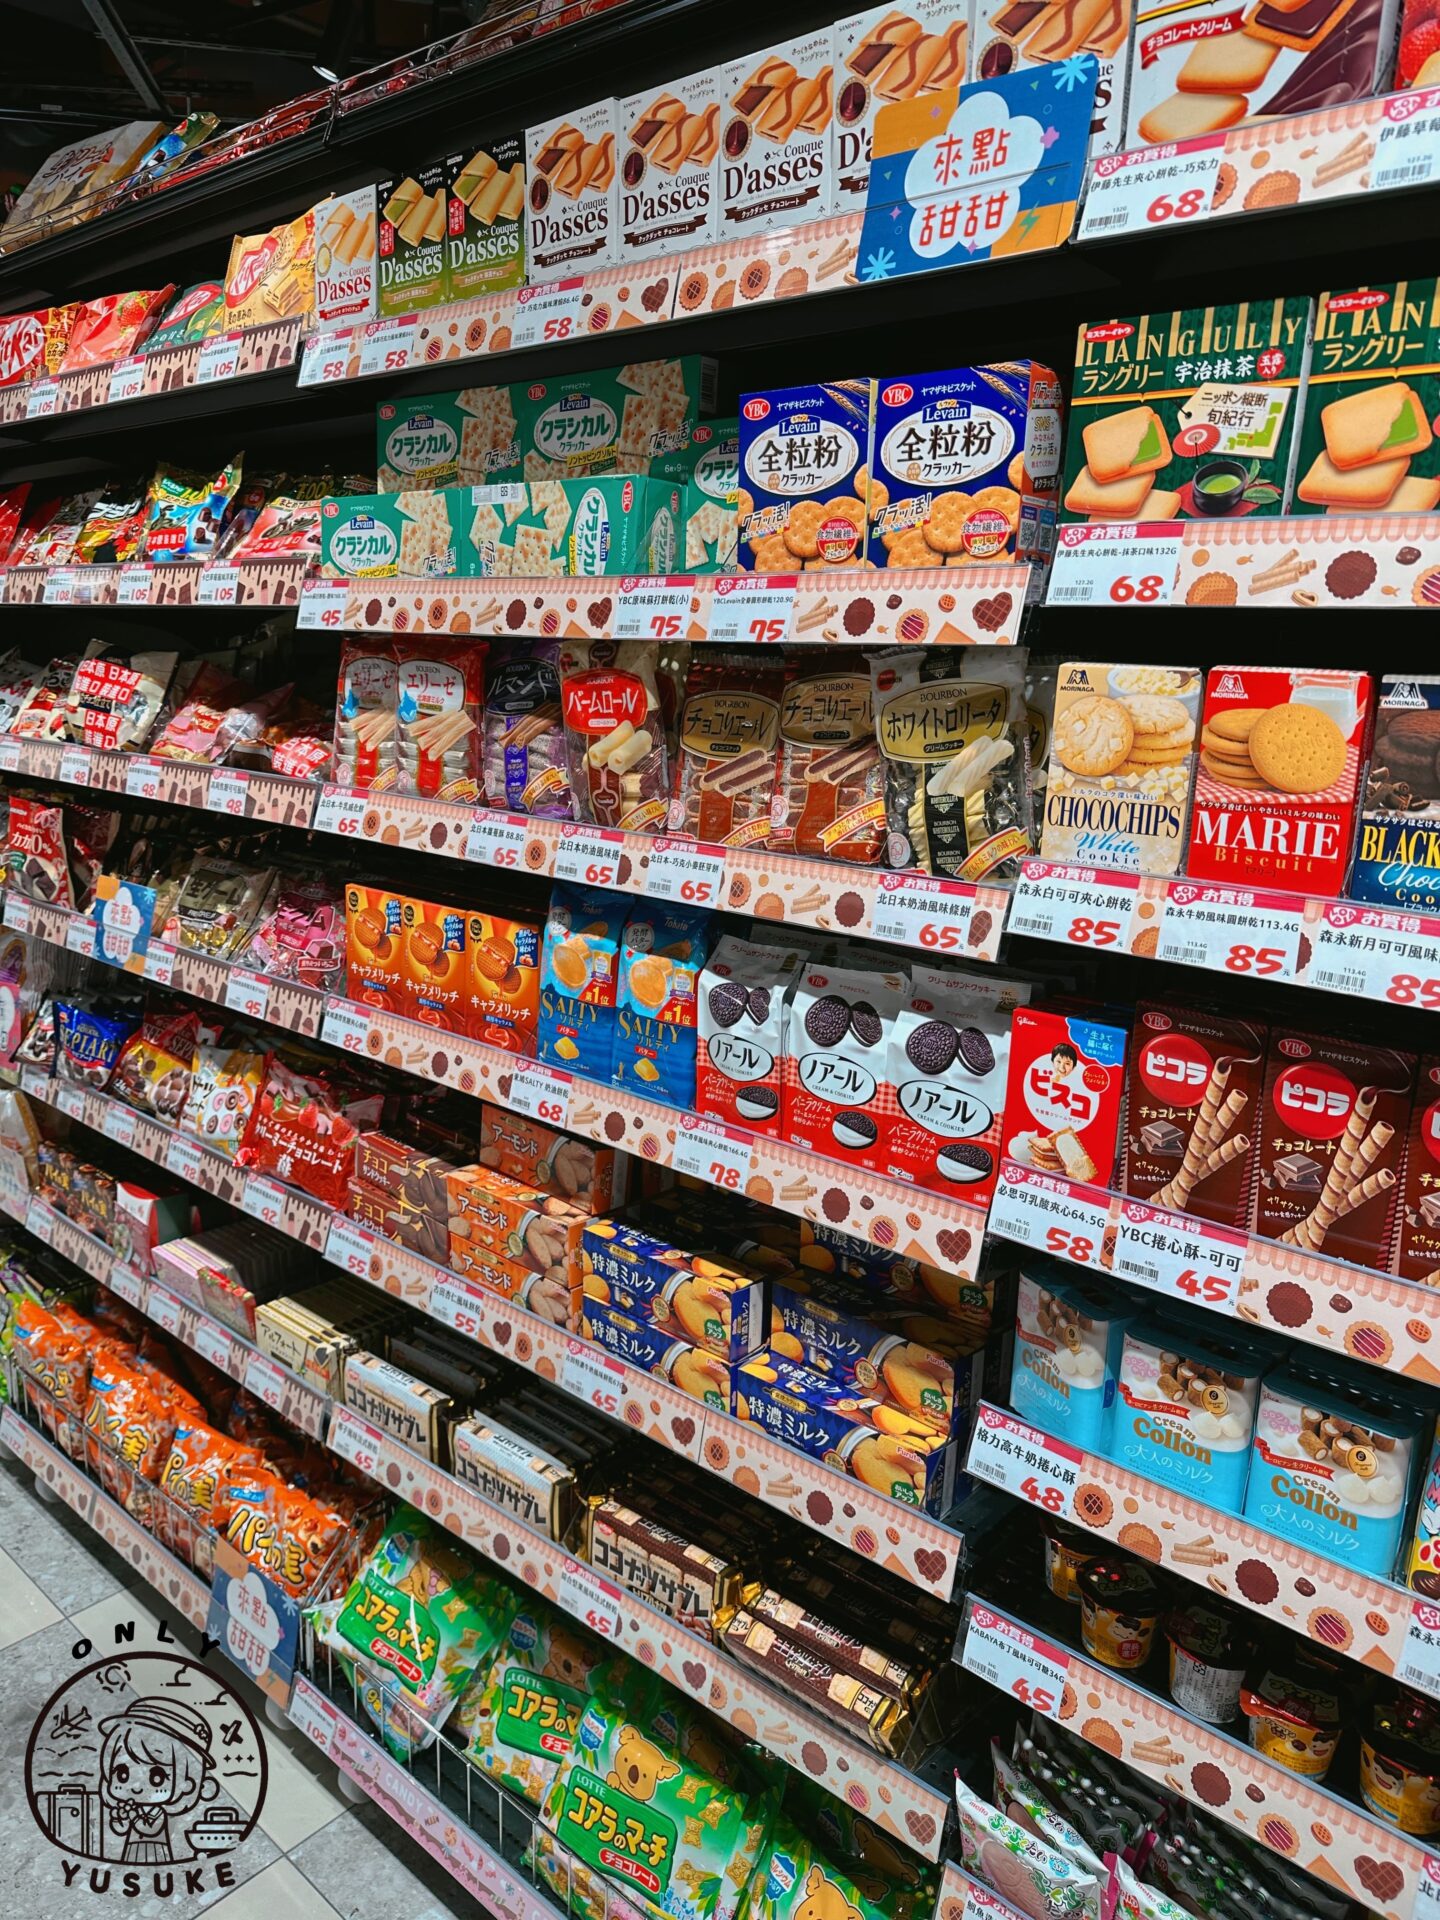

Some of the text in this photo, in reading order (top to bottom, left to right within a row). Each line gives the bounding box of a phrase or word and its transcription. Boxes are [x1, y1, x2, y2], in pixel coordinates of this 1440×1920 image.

[1146, 17, 1232, 50] チョコレートクリーム
[784, 139, 824, 158] Couque
[934, 127, 1012, 186] 來點
[1126, 144, 1178, 165] お買得
[675, 171, 710, 189] Couque
[724, 152, 823, 201] D'asses
[1090, 157, 1219, 192] 伊藤先生夾心餅乾-巧克力
[577, 197, 608, 215] Couque
[623, 183, 710, 227] D'asses
[1146, 189, 1205, 223] 68
[531, 207, 609, 249] D'asses
[919, 190, 1009, 246] 甜甜
[318, 274, 371, 304] D'asses
[1329, 294, 1385, 310] ミスターイトウ
[543, 317, 572, 341] 58
[1085, 325, 1133, 341] ミスターイトウ
[384, 350, 408, 369] 58
[1323, 335, 1425, 368] ラングリー
[214, 361, 233, 378] 105
[323, 361, 344, 380] 58
[1082, 367, 1164, 394] ラングリー
[1174, 355, 1255, 383] 宇治抹茶
[1261, 364, 1278, 375] 入り
[122, 381, 139, 396] 105
[530, 386, 545, 397] YBC
[886, 387, 911, 403] YBC
[921, 382, 977, 396] ヤマザキビスケット
[1201, 390, 1268, 408] ニッポン縦断
[38, 401, 53, 415] 105
[380, 407, 395, 417] YBC
[747, 403, 767, 417] YBC
[925, 405, 968, 421] Levain
[1207, 408, 1256, 427] 旬紀行
[540, 412, 610, 440] クラシカル
[780, 421, 818, 435] Levain
[391, 433, 452, 456] クラシカル
[758, 435, 842, 473] 全粒粉
[896, 421, 996, 462] 全粒粉
[781, 473, 822, 487] クラッカー
[922, 462, 971, 478] クラッカー
[325, 505, 337, 515] YBC
[335, 533, 391, 556] クラシカル
[1090, 526, 1137, 540] お買得
[215, 588, 233, 601] 105
[1109, 575, 1164, 603] 68
[321, 610, 341, 626] 95
[650, 616, 682, 637] 75
[749, 619, 786, 642] 75
[406, 674, 456, 696] エリーゼ
[813, 683, 854, 692] BOURBON
[1060, 685, 1095, 693] MORINAGA
[1210, 691, 1248, 699] MORINAGA
[566, 688, 639, 715] バームロール
[1383, 699, 1426, 708] MORINAGA
[85, 714, 117, 732] 日本原
[687, 708, 775, 741] チョコリエール
[886, 699, 1002, 742] ホワイトロリータ
[74, 771, 87, 784] 98
[142, 784, 156, 797] 98
[1072, 788, 1157, 801] ミルクのコク深い味わい
[226, 800, 243, 814] 98
[1048, 794, 1180, 839] CHOCOCHIPS
[1201, 801, 1340, 821] サクサク香ばしい やさしいミルクの味わい
[338, 818, 359, 834] 65
[1193, 810, 1340, 860] MARIE
[1074, 830, 1141, 855] White
[1360, 825, 1440, 868] BLACK
[493, 847, 518, 866] 65
[1077, 849, 1140, 866] Cookie
[1215, 847, 1313, 873] Biscuit
[585, 864, 614, 884] 65
[680, 880, 713, 901] 65
[1019, 883, 1133, 912] 森永白可可夾心餅乾
[877, 893, 970, 918] 北日本奶油風味條餅
[1067, 917, 1121, 946] 85
[1166, 907, 1300, 933] 森永牛奶風味圓餅乾113.4G
[919, 923, 962, 949] 65
[1225, 944, 1287, 975] 85
[155, 967, 169, 981] 95
[350, 961, 400, 985] キャラメリッチ
[405, 980, 459, 1003] キャラメリッチ
[1386, 974, 1440, 1008] 85
[245, 1000, 262, 1015] 95
[471, 995, 531, 1021] キャラメリッチ
[541, 991, 599, 1023] SALTY
[664, 1005, 691, 1025] 第1位
[617, 1010, 682, 1043] SALTY
[1017, 1016, 1038, 1026] Glico
[343, 1034, 362, 1051] 82
[715, 1039, 761, 1069] ノアール
[805, 1061, 865, 1095] ノアール
[1146, 1051, 1208, 1085] ピコラ
[1030, 1067, 1091, 1120] ビスコ
[1281, 1080, 1349, 1116] ピコラ
[537, 1099, 562, 1122] 68
[909, 1089, 976, 1125] ノアール
[1138, 1106, 1197, 1122] チョコレート
[493, 1126, 538, 1157] アーモンド
[888, 1125, 936, 1146] バニラクリーム
[362, 1149, 389, 1174] チョコ
[709, 1162, 740, 1188] 78
[353, 1193, 385, 1223] チョコ
[458, 1195, 508, 1230] アーモンド
[998, 1184, 1105, 1229] 必思可乳酸夾心64.5G
[1045, 1226, 1094, 1262] 58
[1120, 1224, 1242, 1273] YBC捲心酥-可可
[347, 1254, 367, 1274] 55
[462, 1253, 512, 1290] アーモンド
[592, 1252, 656, 1293] 特濃ミルク
[1175, 1269, 1231, 1302] 45
[454, 1312, 476, 1333] 55
[783, 1307, 861, 1357] 特濃ミルク
[592, 1319, 656, 1363] 特濃ミルク
[347, 1383, 427, 1444] ココナッツサブレ
[748, 1395, 830, 1447] 特濃ミルク
[1133, 1417, 1212, 1466] Collon
[896, 1446, 922, 1463] Furuta
[977, 1427, 1076, 1485] 格力高牛奶捲心酥
[1124, 1444, 1214, 1485] 大人のミルク
[457, 1454, 546, 1524] ココナッツサブレ
[1020, 1477, 1065, 1512] 48
[1271, 1475, 1358, 1531] Collon
[1260, 1504, 1360, 1550] 大人のミルク
[595, 1537, 709, 1617] ココナッツサブレ
[586, 1610, 611, 1633] 45
[970, 1625, 1065, 1684] KABAYA布丁風味可可糖34G
[512, 1674, 542, 1689] LOTTE
[1012, 1678, 1055, 1711] 45
[576, 1773, 607, 1797] LOTTE
[568, 1786, 668, 1864] コアラのマーチ
[604, 1851, 658, 1890] チョコレート
